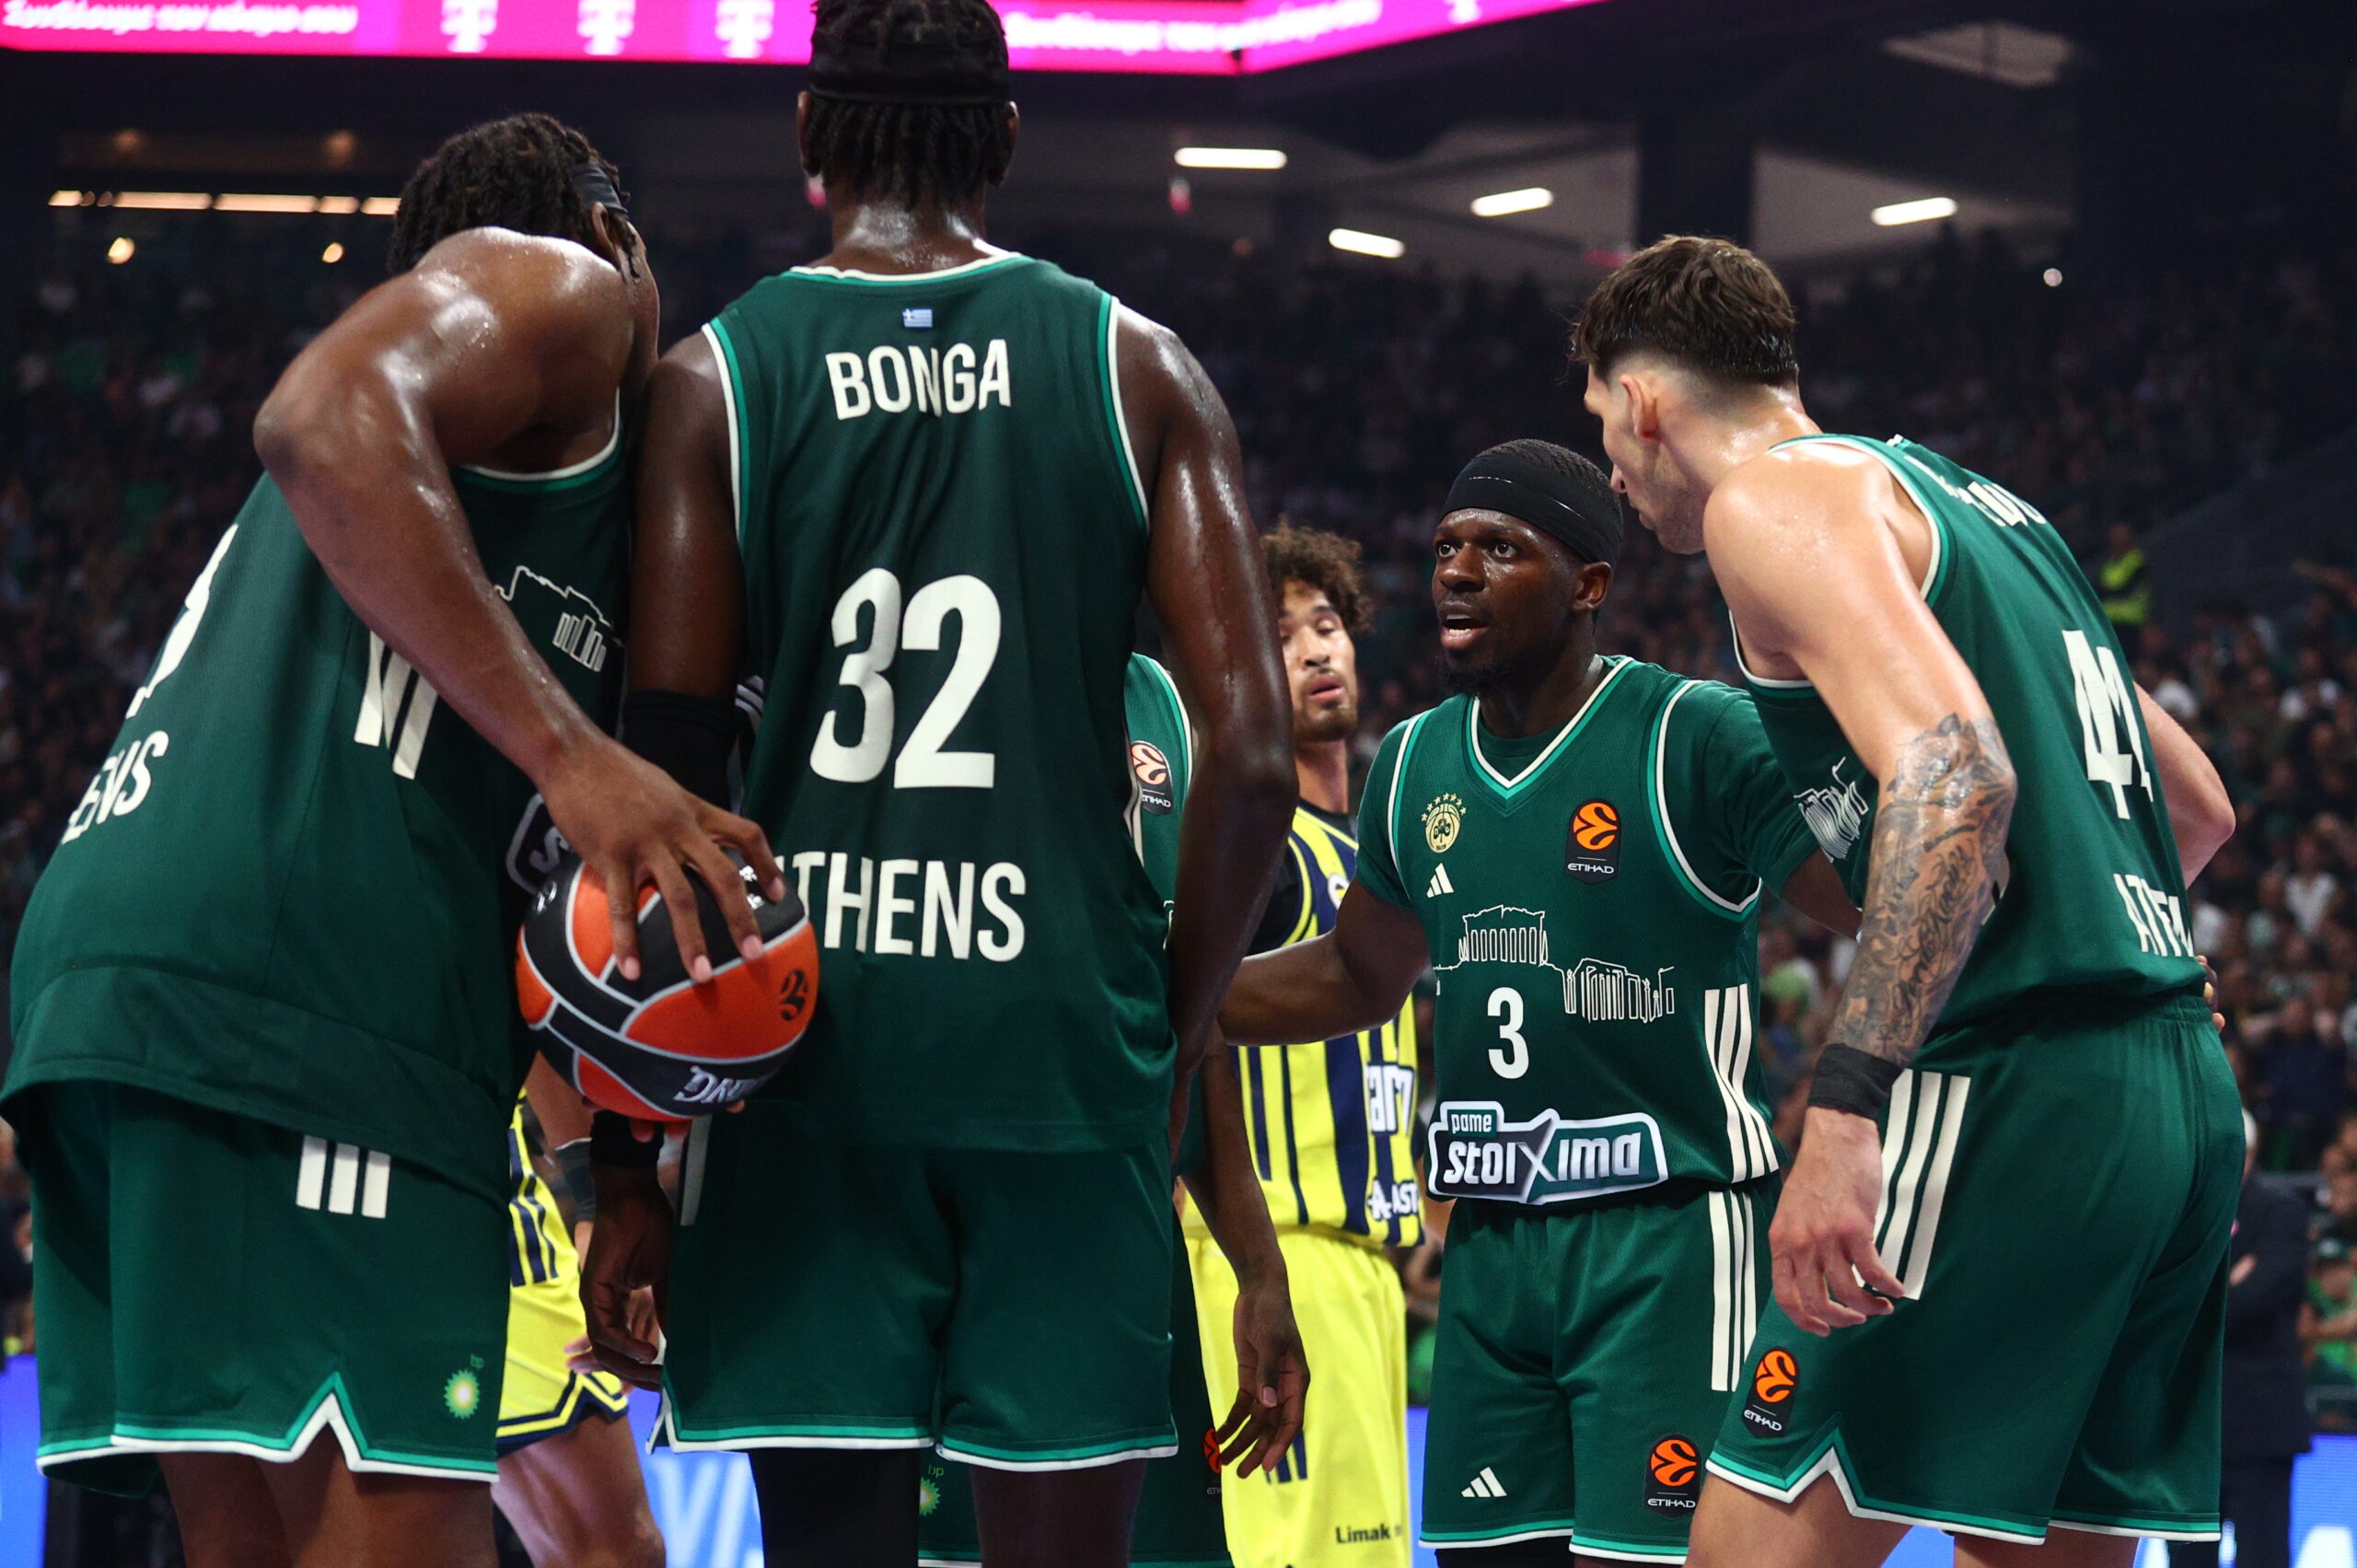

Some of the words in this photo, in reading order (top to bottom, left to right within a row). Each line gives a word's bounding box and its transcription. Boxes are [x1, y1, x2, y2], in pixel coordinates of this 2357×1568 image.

[825, 339, 1012, 421] BONGA
[809, 567, 1002, 789] 32
[1567, 862, 1614, 874] ETIHAD
[775, 851, 1027, 962] THENS
[1487, 986, 1529, 1080] 3
[1451, 1113, 1492, 1134] pame
[1743, 1409, 1782, 1432] ETIHAD
[1647, 1498, 1697, 1508] ETIHAD
[1335, 1523, 1391, 1544] Limak
